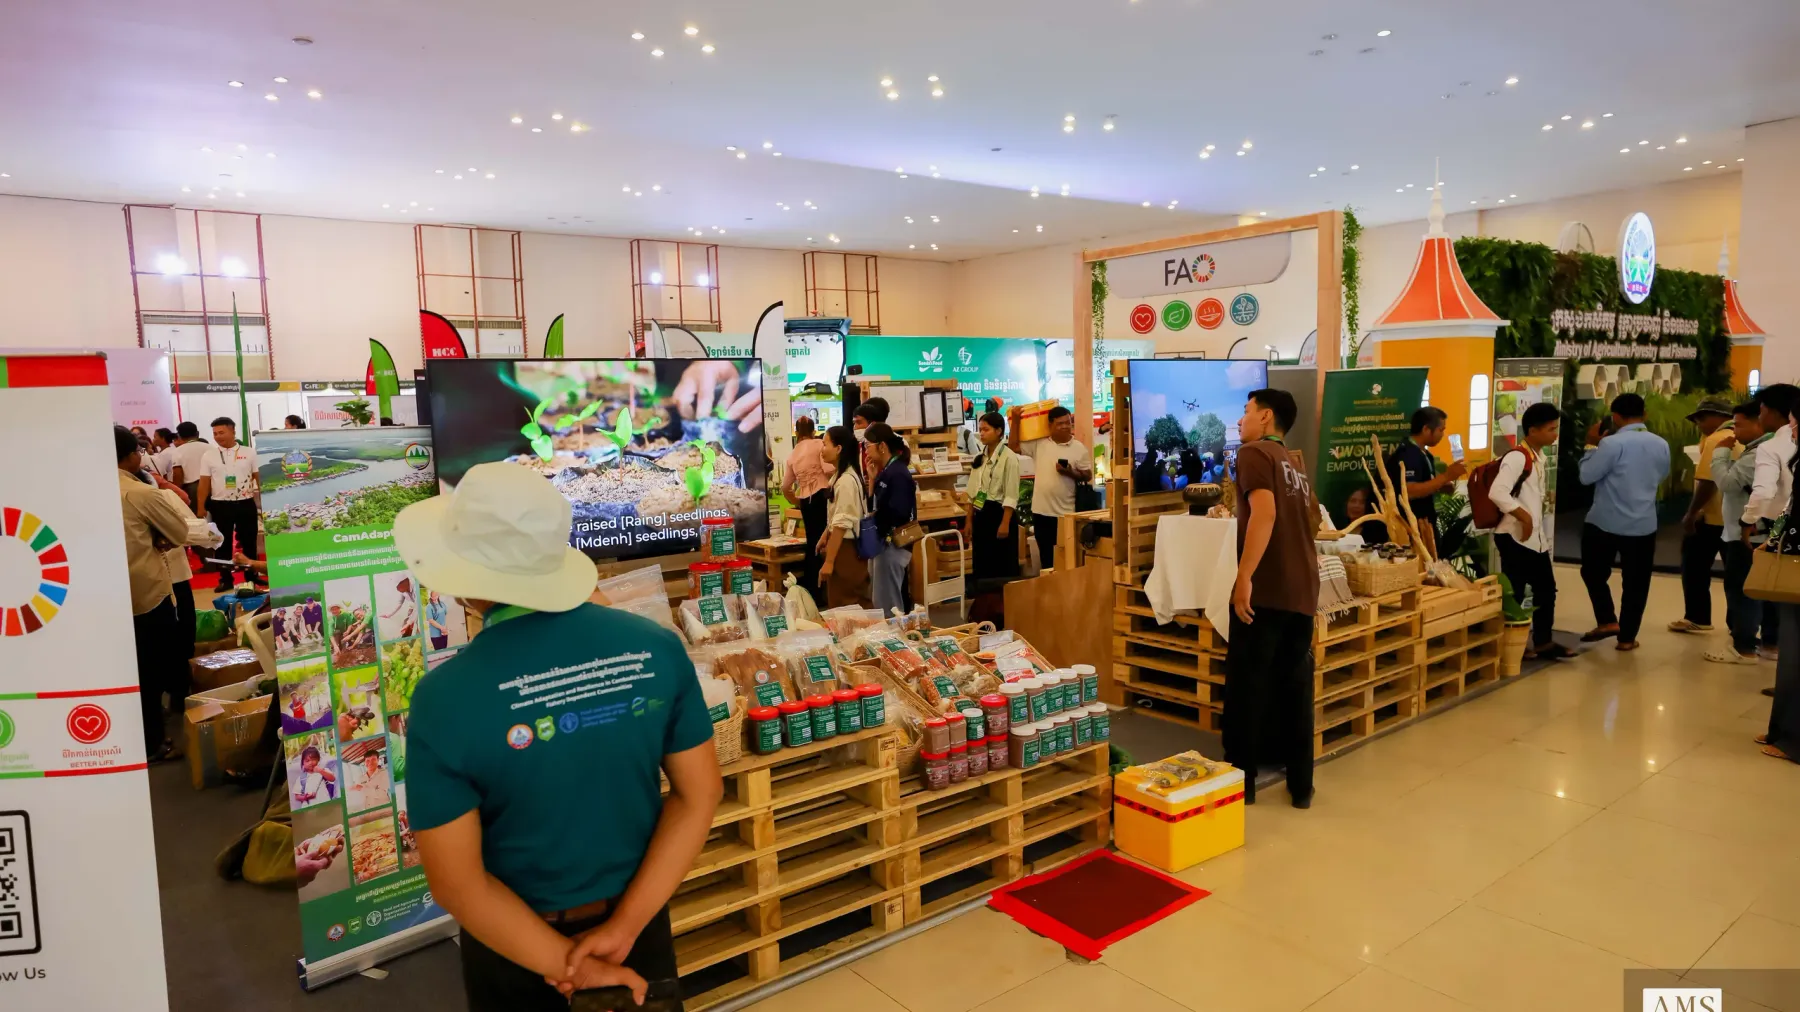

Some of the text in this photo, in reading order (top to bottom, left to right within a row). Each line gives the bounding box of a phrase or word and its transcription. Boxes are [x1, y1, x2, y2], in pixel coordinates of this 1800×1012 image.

[1164, 254, 1215, 286] FAO
[1554, 340, 1582, 360] Ministry
[1583, 340, 1592, 358] of
[1631, 341, 1658, 362] Forestry
[1660, 342, 1671, 359] and
[1672, 342, 1697, 359] Fisheries
[1326, 460, 1377, 472] EMPOWE
[577, 518, 616, 532] raised
[621, 513, 666, 530] [Raing]
[576, 533, 632, 550] [Mdenh]
[635, 528, 698, 543] seedlings,
[511, 700, 534, 710] Climate
[534, 692, 565, 703] Adaptation
[577, 682, 604, 692] Resilience
[546, 684, 632, 708] Fishery Dependent Communities
[0, 967, 46, 982] w Us
